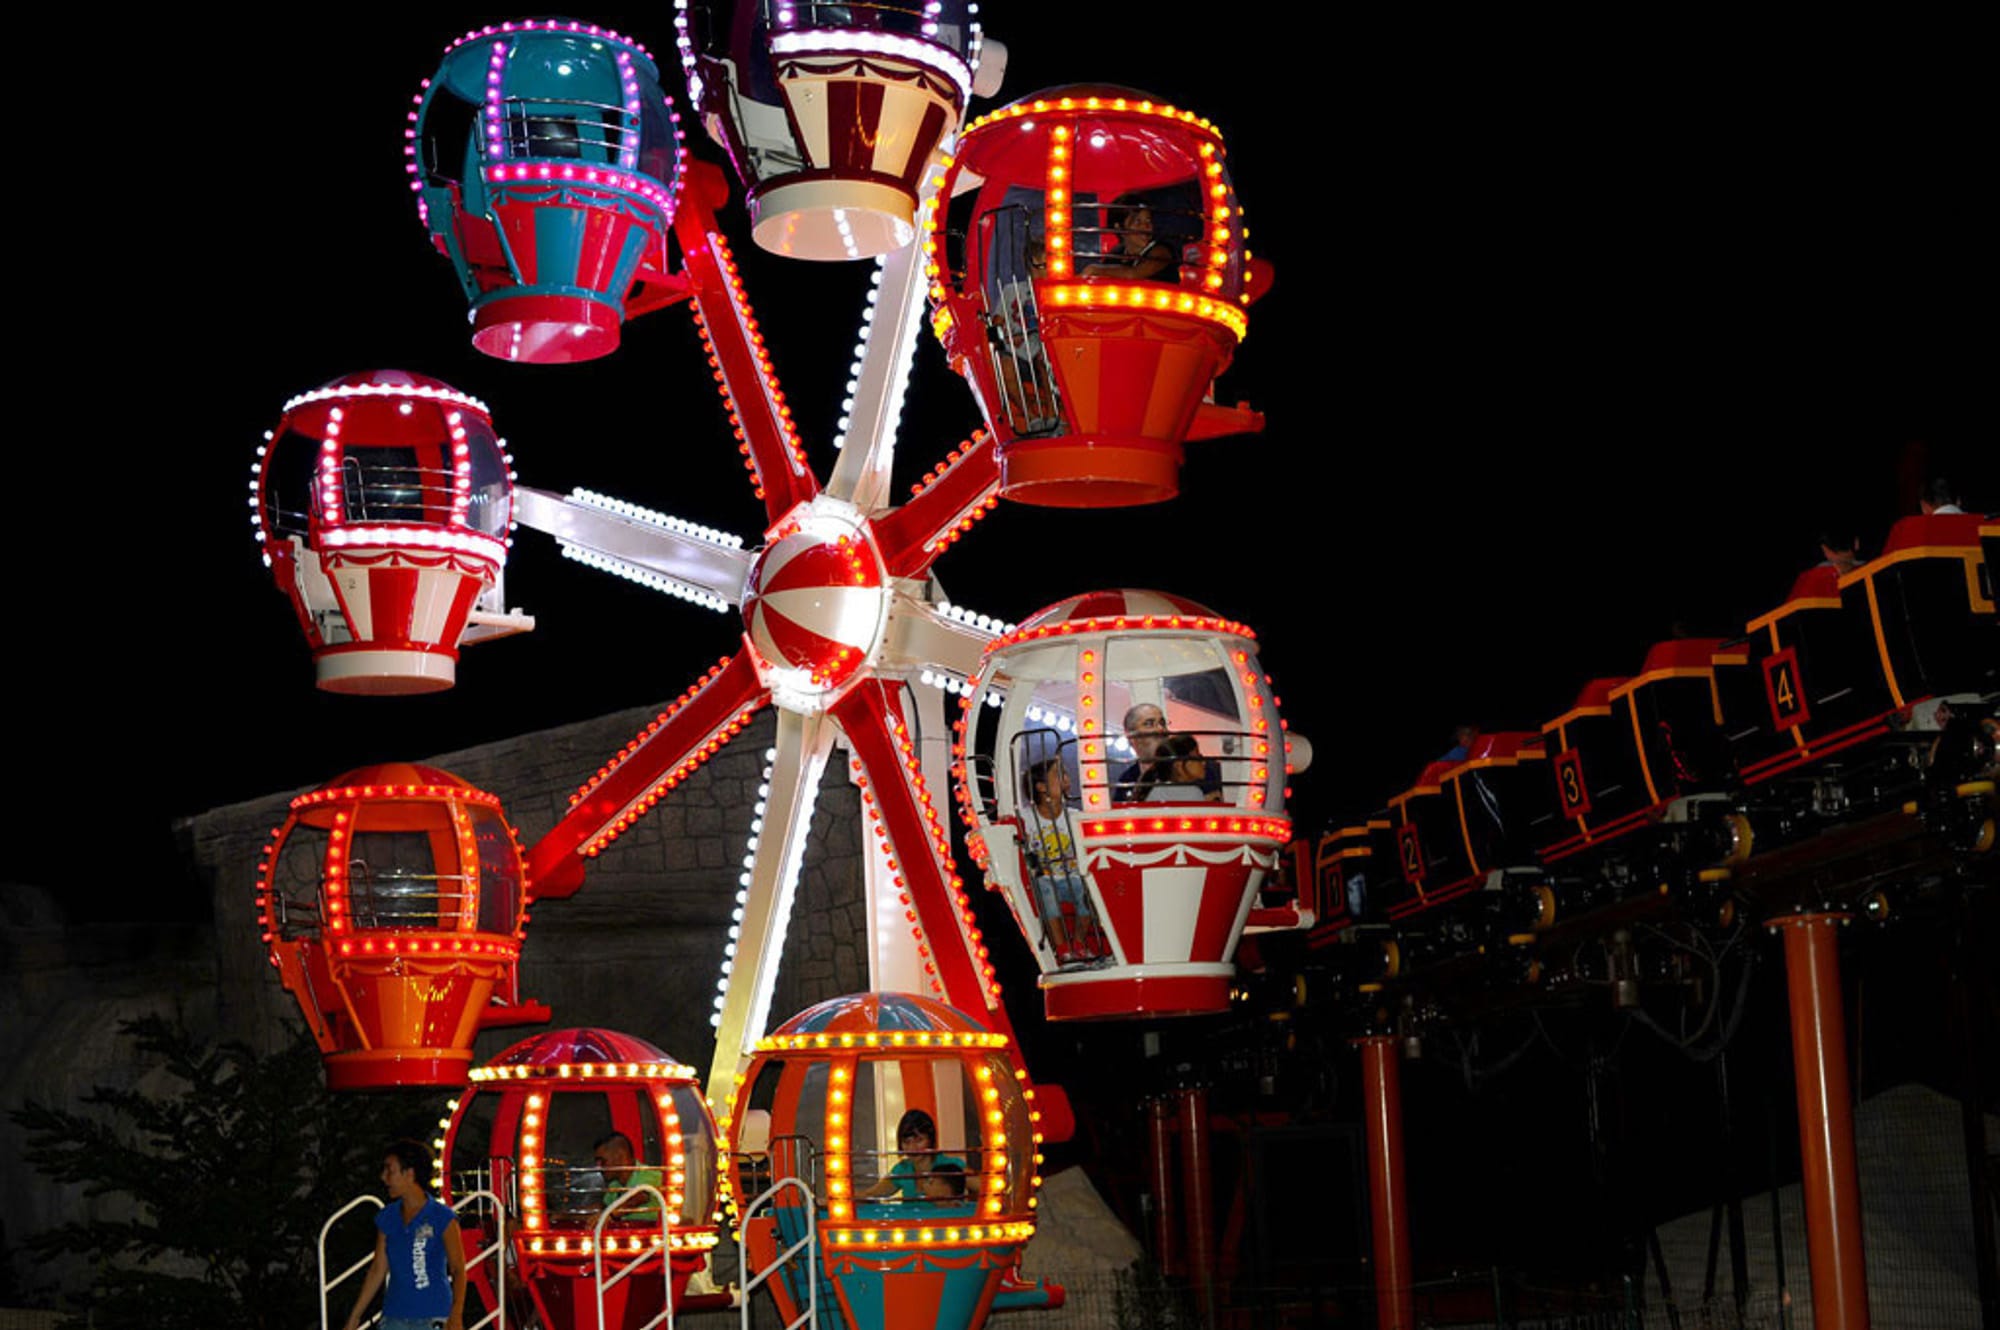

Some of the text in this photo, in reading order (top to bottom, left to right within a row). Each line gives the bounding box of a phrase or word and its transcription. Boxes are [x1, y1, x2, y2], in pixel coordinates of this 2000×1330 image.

[1777, 666, 1794, 711] 4
[1563, 765, 1580, 804] 3
[1403, 837, 1417, 870] 2
